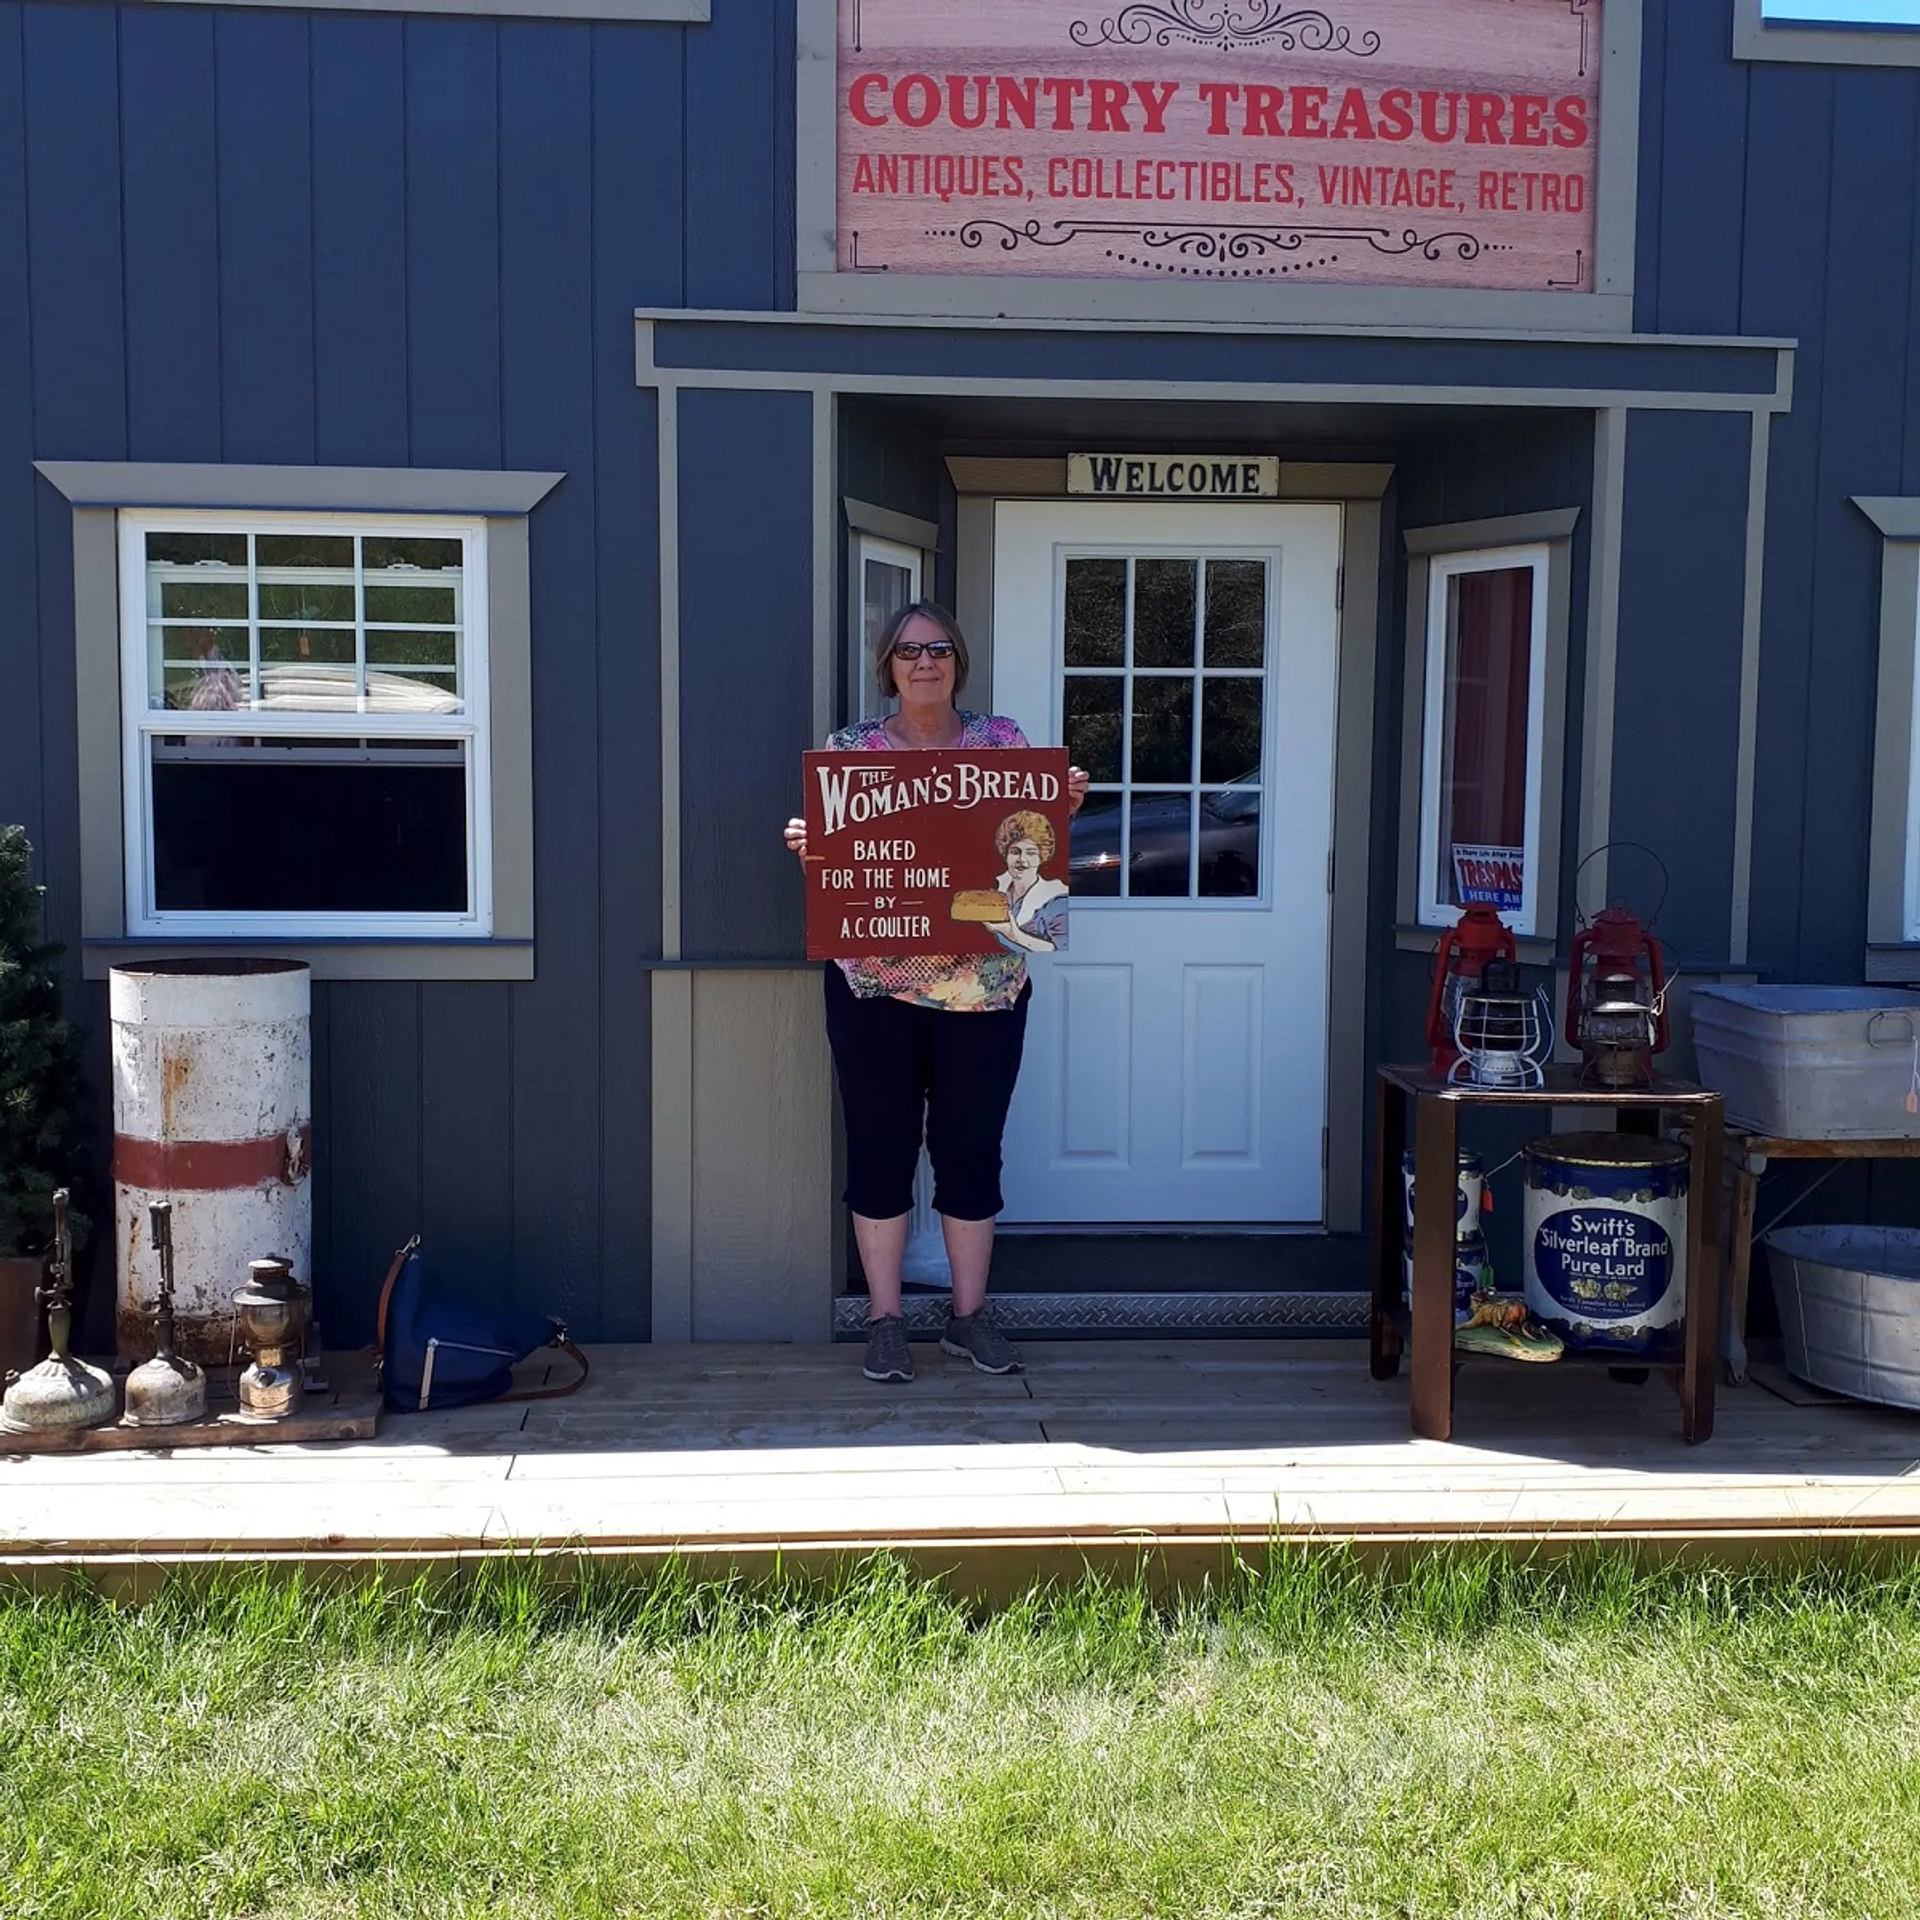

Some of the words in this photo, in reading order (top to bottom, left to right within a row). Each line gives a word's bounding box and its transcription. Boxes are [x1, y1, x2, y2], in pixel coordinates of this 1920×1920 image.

[847, 71, 1179, 134] COUNTRY
[1199, 81, 1589, 148] TREASURES
[851, 153, 1034, 200] ANTIQUES,
[1047, 157, 1306, 208] COLLECTIBLES,
[1317, 164, 1466, 212] VINTAGE,
[1478, 170, 1585, 214] RETRO
[1088, 457, 1261, 494] WELCOME
[858, 769, 896, 789] THE
[953, 763, 1060, 810] BREAD
[816, 765, 953, 836] WOMAN'S
[853, 839, 917, 861] BAKED
[821, 868, 855, 890] FOR
[863, 868, 895, 890] THE
[904, 867, 951, 889] HOME
[875, 896, 896, 909] BY
[1468, 890, 1500, 902] HERE
[1571, 1215, 1635, 1237] Swift's
[1625, 1236, 1668, 1257] Brand
[1562, 1253, 1602, 1275] Pure
[1605, 1258, 1645, 1276] Lard
